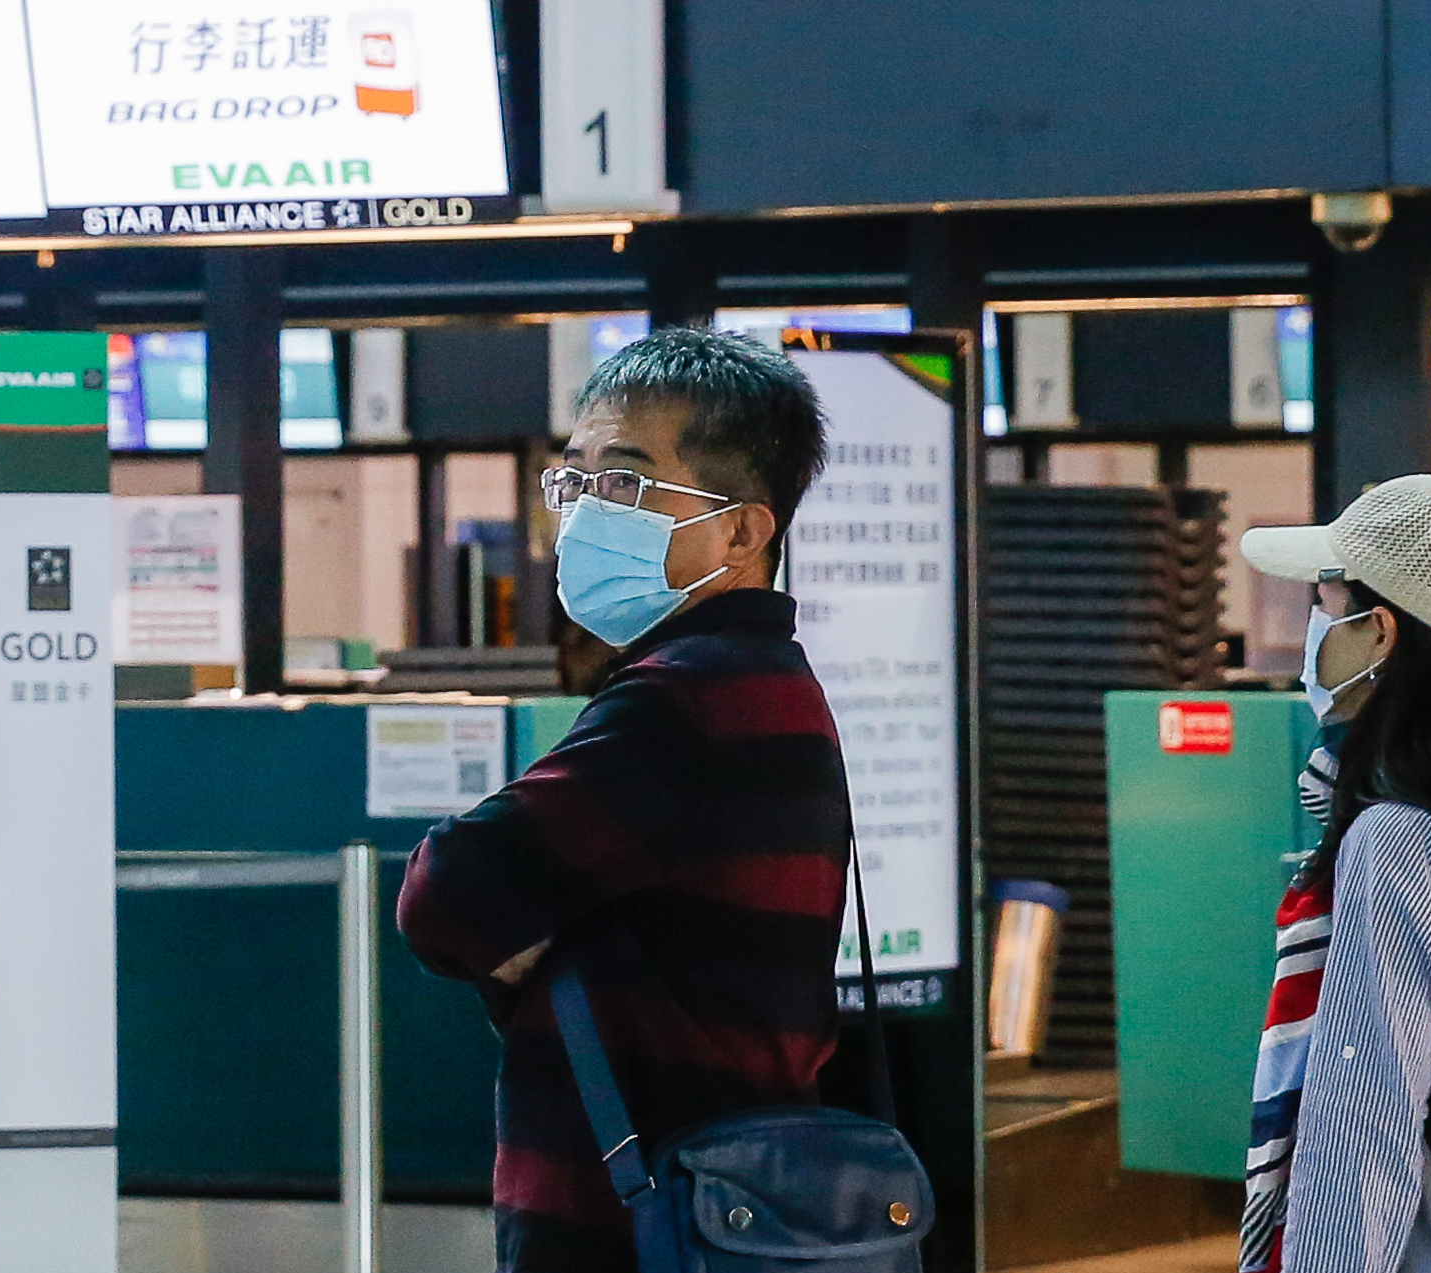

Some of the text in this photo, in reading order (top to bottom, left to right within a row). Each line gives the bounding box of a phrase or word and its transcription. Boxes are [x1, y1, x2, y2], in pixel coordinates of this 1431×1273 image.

[130, 13, 331, 76] 行李託運
[106, 91, 340, 126] BAG DROP
[584, 112, 610, 176] 1
[172, 156, 374, 191] EVA AIR
[83, 196, 472, 236] STAR ALLIANCE GOLD
[1, 632, 97, 661] GOLD
